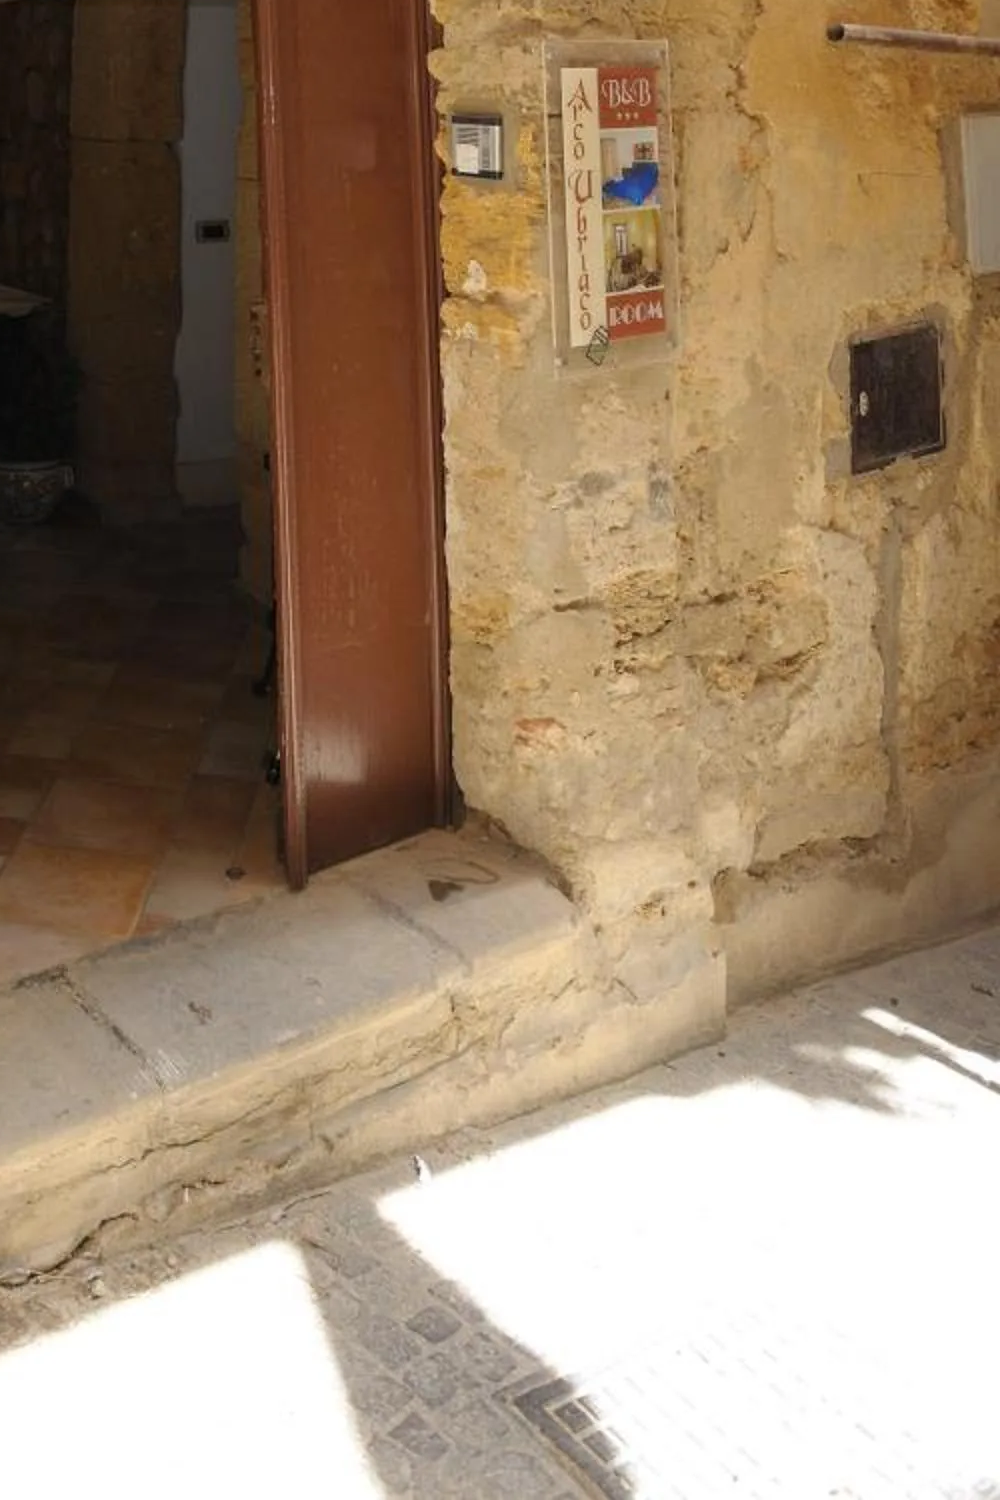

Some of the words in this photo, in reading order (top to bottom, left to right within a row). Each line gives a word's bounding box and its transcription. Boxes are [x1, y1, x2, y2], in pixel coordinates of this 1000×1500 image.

[567, 78, 593, 161] Arco
[601, 77, 652, 108] B&B
[568, 169, 594, 330] Ubriaco
[609, 300, 664, 327] ROOM
